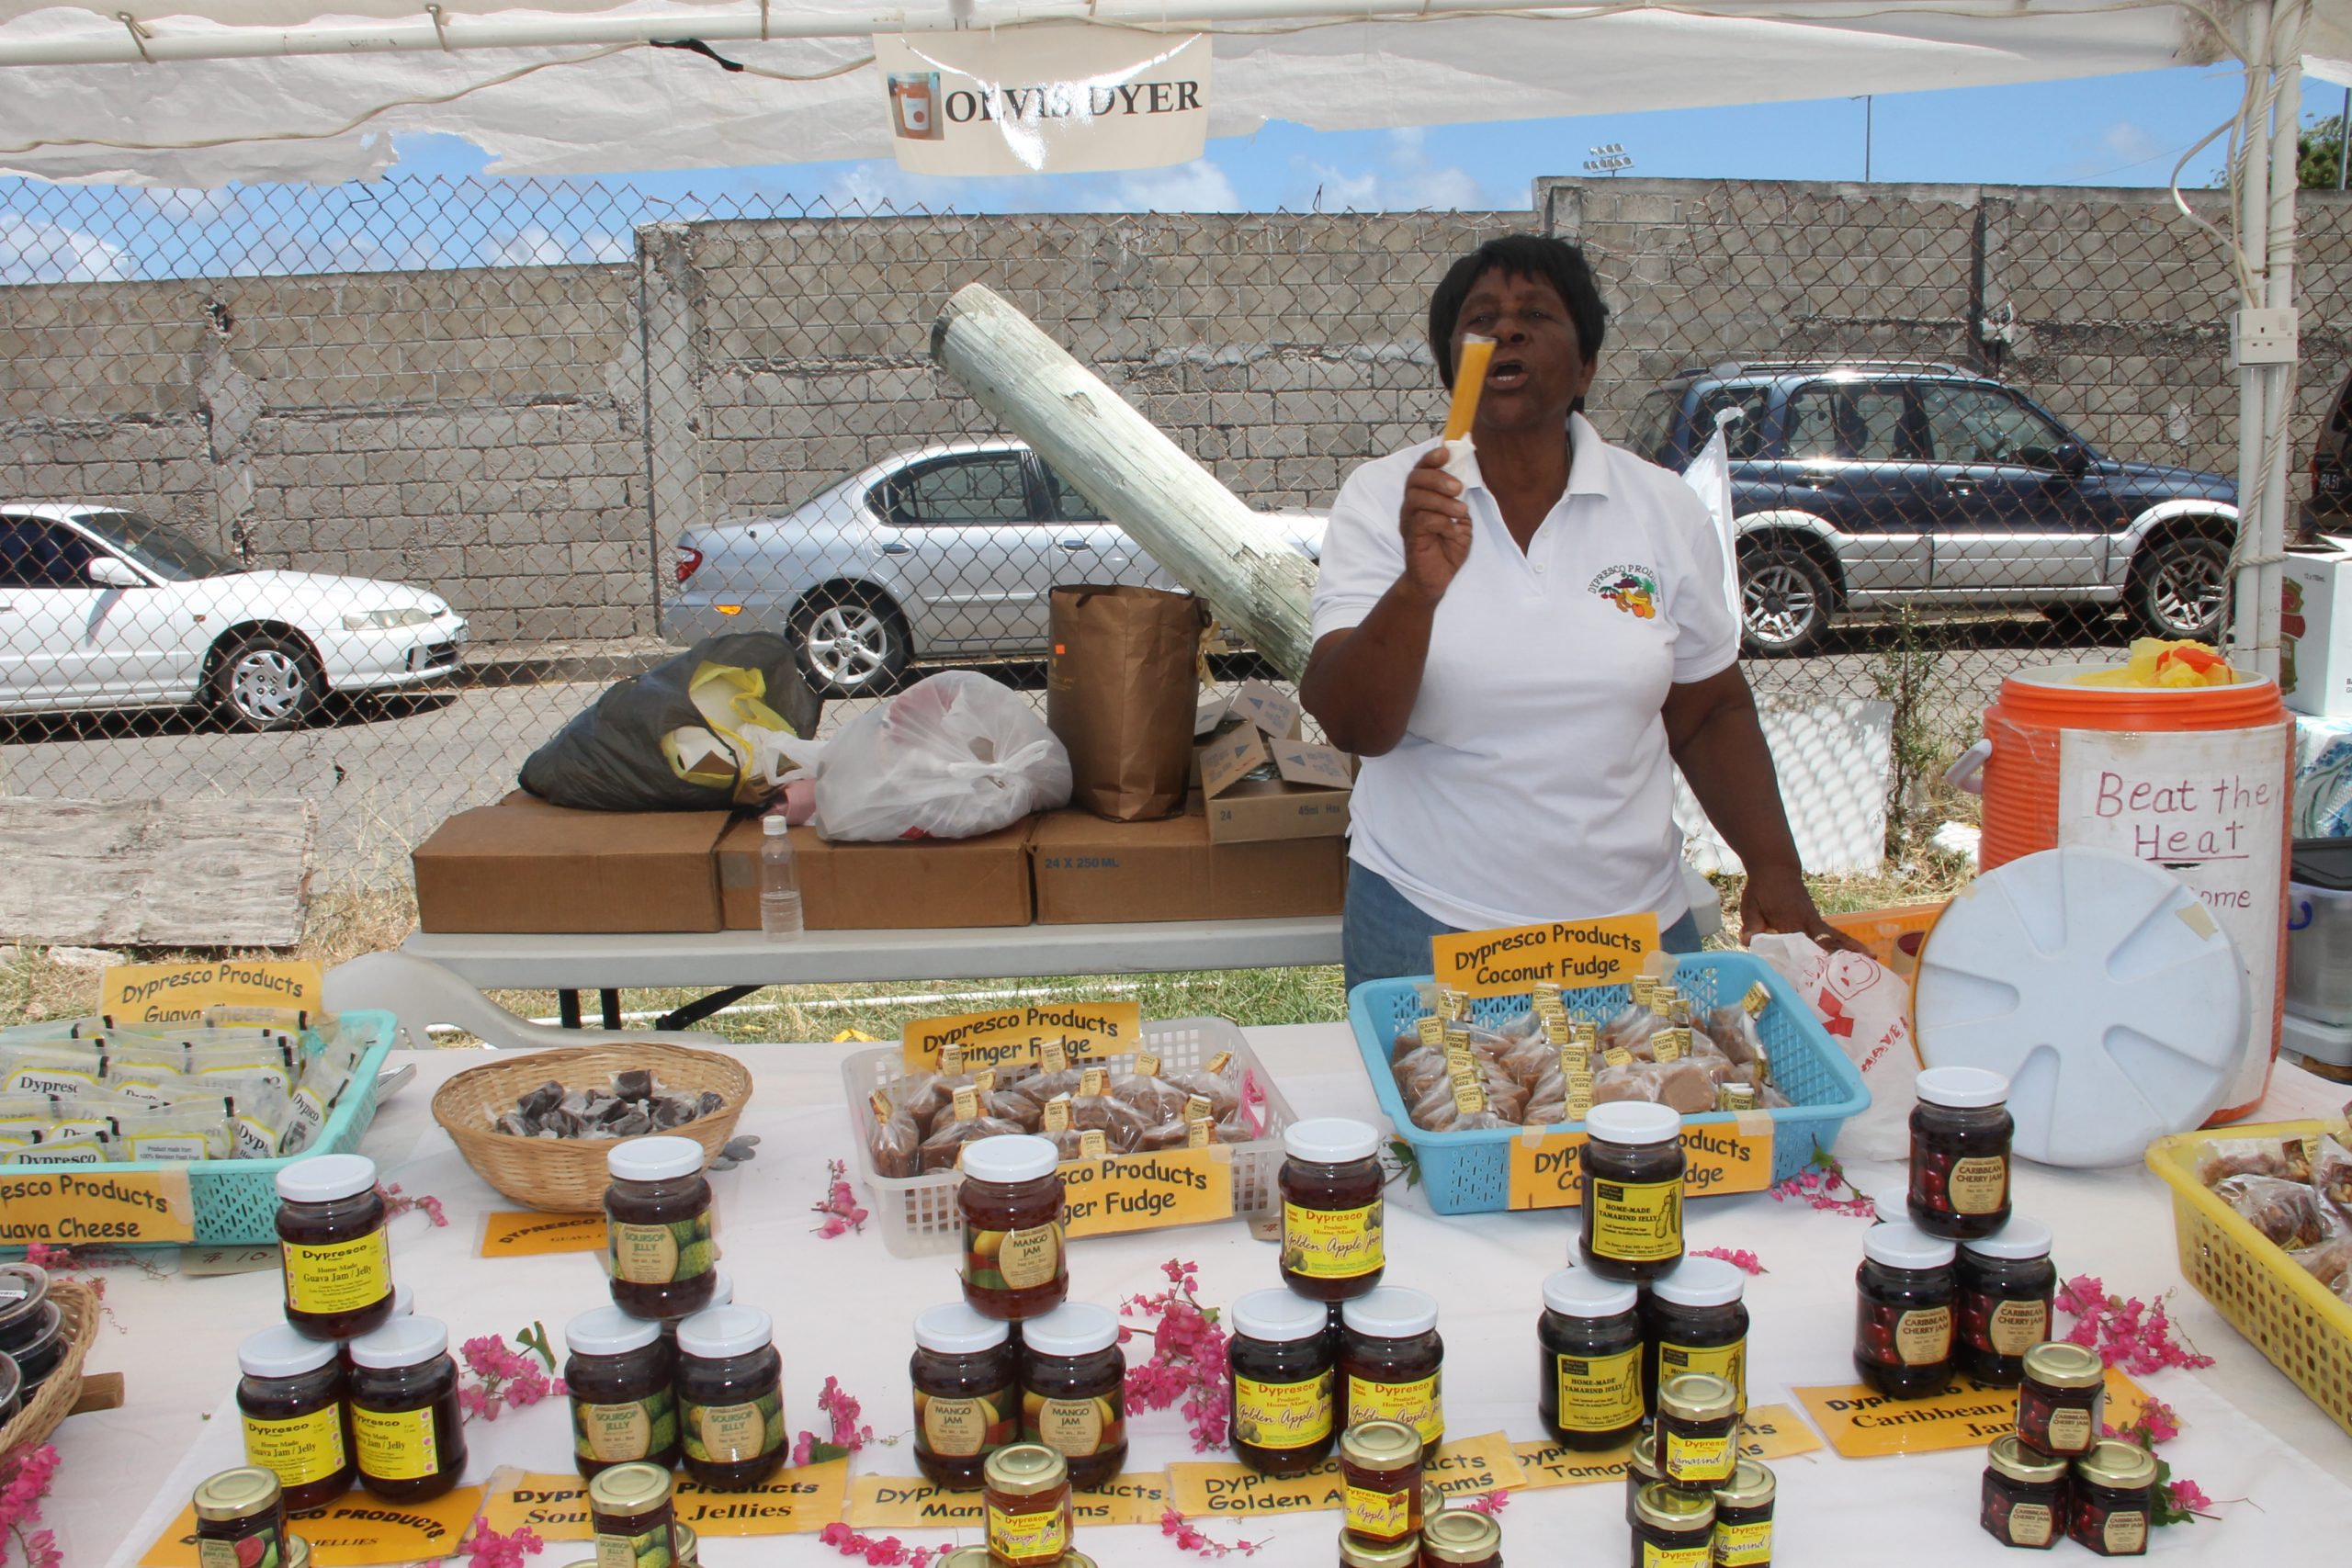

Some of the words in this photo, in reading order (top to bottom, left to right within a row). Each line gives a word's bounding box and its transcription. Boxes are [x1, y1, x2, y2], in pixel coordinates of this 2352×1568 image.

[1090, 79, 1202, 116] DYER
[1588, 564, 1626, 594] DYPRESCO
[2095, 771, 2199, 818] Beat
[2212, 774, 2271, 816] the
[1220, 810, 1232, 821] 24
[2135, 820, 2245, 857] Heat
[1046, 859, 1060, 869] 24
[1077, 858, 1100, 868] 250
[2189, 886, 2251, 908] ome
[1455, 931, 1546, 971] Dypresco
[1553, 924, 1641, 953] Products
[1476, 960, 1555, 986] Coconut
[1562, 955, 1621, 979] Fudge
[121, 967, 212, 1004] Dypresco
[219, 964, 304, 998] Products
[144, 1005, 201, 1022] Guava
[923, 1014, 1020, 1052] Dypresco
[1026, 1008, 1118, 1037] Products
[1030, 1038, 1091, 1060] Fdge
[1678, 1130, 1751, 1162] oducts
[1102, 1158, 1206, 1190] Products
[1683, 1162, 1724, 1189] dge
[1958, 1165, 2002, 1174] CARIBBEAN
[1956, 1174, 1987, 1183] CHERRY
[1988, 1174, 2003, 1183] JAM
[60, 1174, 167, 1213] Products
[1064, 1201, 1098, 1226] ger
[1106, 1188, 1176, 1216] Fudge
[1605, 1203, 1651, 1213] HOME-MADE
[1306, 1210, 1363, 1224] Dypresco
[1599, 1211, 1636, 1222] TAMARIND
[0, 1223, 51, 1238] uava
[58, 1217, 141, 1238] Cheese
[499, 1218, 597, 1243] DYPRESCO
[1013, 1235, 1048, 1247] MANGO
[1287, 1230, 1321, 1251] Golden
[1327, 1236, 1363, 1258] Apple
[302, 1245, 368, 1260] Dypresco
[1023, 1246, 1041, 1258] JAM
[303, 1272, 329, 1282] Guava
[331, 1271, 349, 1282] Jam
[356, 1265, 372, 1278] Jelly
[1905, 1314, 1948, 1325] CARIBBEAN
[1997, 1316, 2029, 1325] CHERRY
[2030, 1315, 2043, 1325] JAM
[2000, 1307, 2043, 1317] CARIBBEAN
[1903, 1325, 1934, 1335] CHERRY
[1935, 1323, 1949, 1332] JAM
[1258, 1383, 1315, 1396] Dypresco
[1374, 1382, 1430, 1395] Dypresco
[1564, 1385, 1602, 1394] TAMARIND
[1604, 1384, 1623, 1393] JELLY
[1571, 1378, 1616, 1386] HOME-MADE
[935, 1405, 972, 1416] MANGO
[1052, 1407, 1090, 1417] MANGO
[1239, 1403, 1274, 1423] Golden
[1280, 1406, 1316, 1429] Apple
[1851, 1404, 2007, 1428] Caribbean
[249, 1422, 310, 1435] Dypresco
[944, 1416, 963, 1425] JAM
[1061, 1417, 1080, 1426] JAM
[273, 1447, 290, 1457] Jam
[298, 1443, 317, 1455] Jelly
[387, 1441, 405, 1451] Jelly
[1673, 1449, 1722, 1464] Tamarind
[1544, 1460, 1633, 1478] Tamar
[1208, 1493, 1312, 1510] Golden
[1435, 1472, 1495, 1492] ams
[687, 1503, 792, 1521] Jellies
[921, 1504, 984, 1517] Man
[1072, 1505, 1110, 1517] ms
[1358, 1504, 1385, 1524] Apple
[334, 1508, 447, 1539] PRODUCTS
[1718, 1535, 1765, 1551] Tamarind
